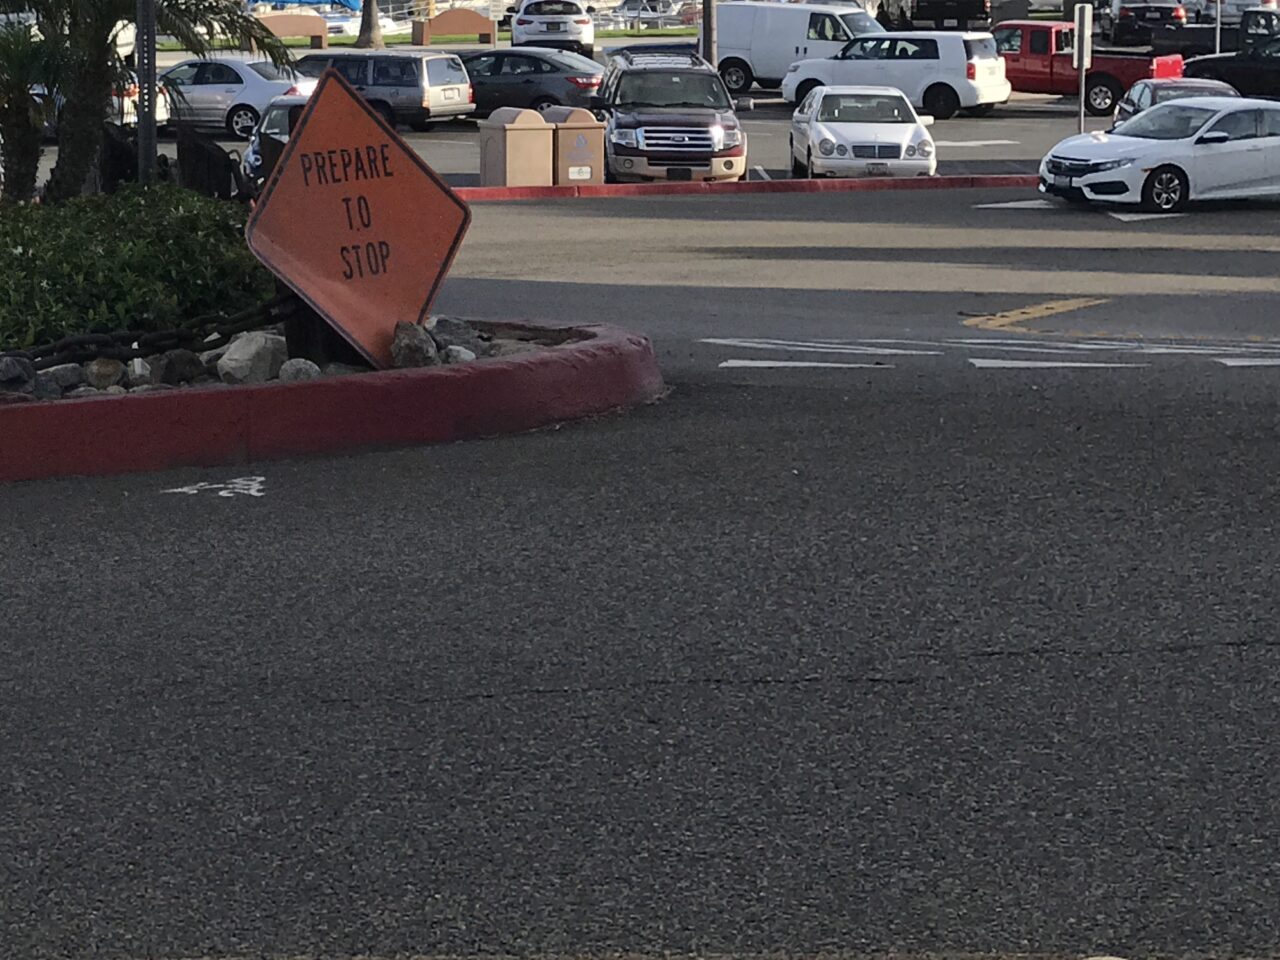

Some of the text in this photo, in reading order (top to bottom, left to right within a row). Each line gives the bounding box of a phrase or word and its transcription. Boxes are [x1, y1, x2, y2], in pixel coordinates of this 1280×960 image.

[300, 144, 394, 186] PREPARE
[342, 195, 372, 231] TO
[340, 241, 391, 280] STOP
